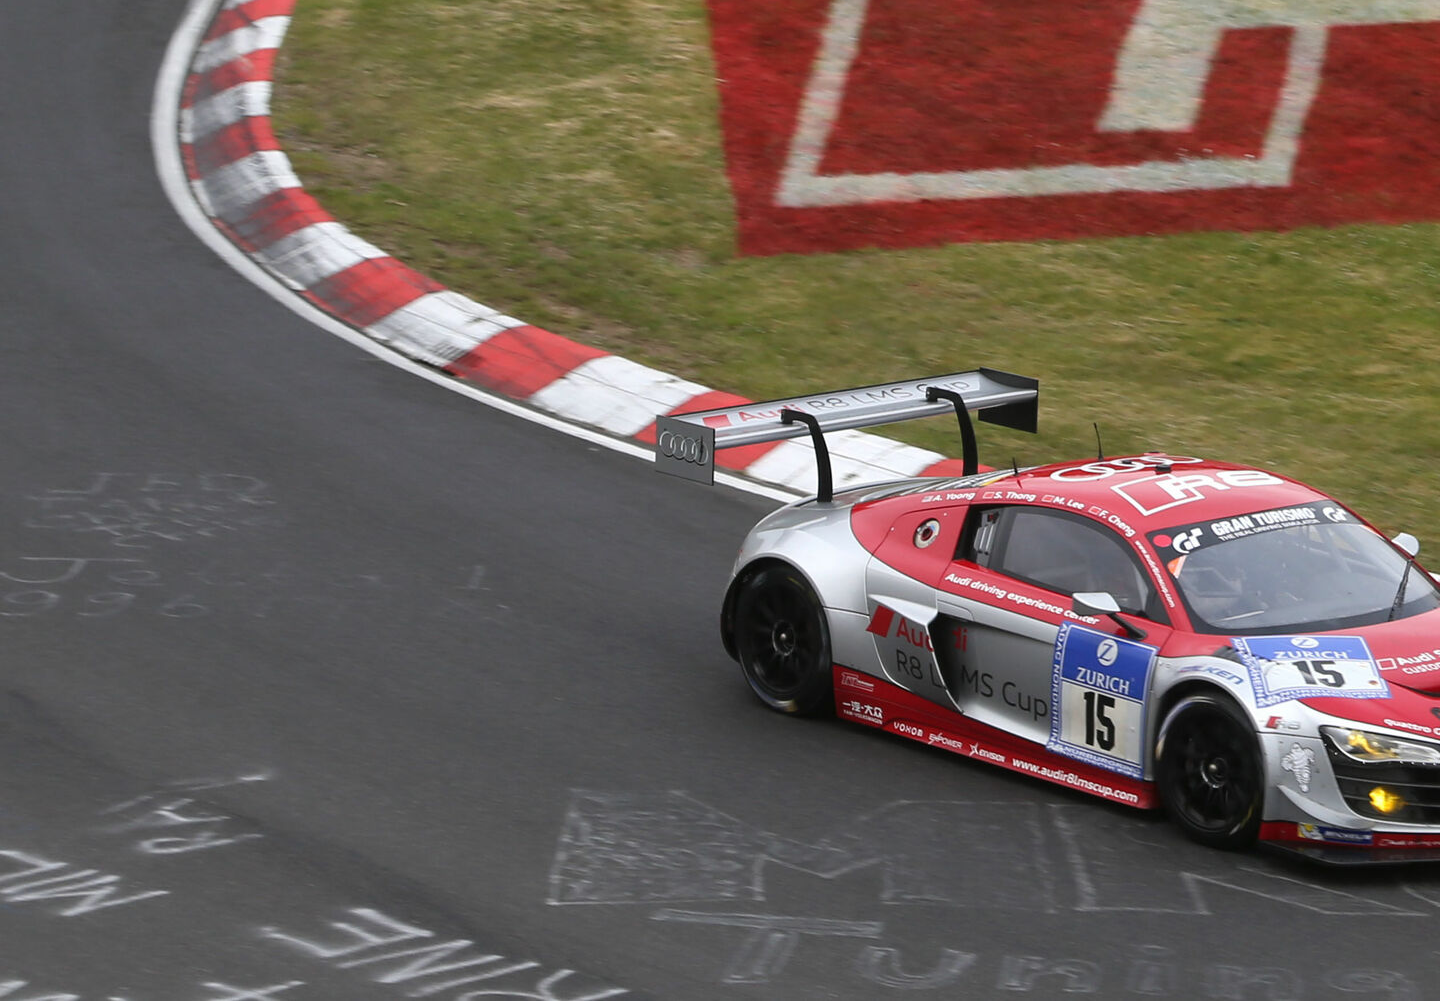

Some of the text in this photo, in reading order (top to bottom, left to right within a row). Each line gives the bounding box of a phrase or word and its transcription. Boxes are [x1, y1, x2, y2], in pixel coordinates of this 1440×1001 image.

[806, 397, 849, 411] R8
[852, 386, 907, 406] LMS
[946, 491, 977, 502] Yoong
[1005, 491, 1037, 503] Thong
[1068, 499, 1086, 511] Lee
[1108, 514, 1137, 538] Cheng
[1210, 506, 1316, 536] GRAN TURISMO
[945, 572, 970, 587] Audi
[970, 580, 1006, 600] driving
[1006, 590, 1063, 616] experience
[1274, 650, 1349, 659] ZURICH
[1396, 651, 1437, 667] Audi
[896, 649, 923, 680] R8
[1002, 681, 1048, 721] Cup
[1076, 666, 1130, 695] ZURICH
[1293, 660, 1347, 688] 15
[1083, 691, 1116, 752] 15
[1383, 718, 1432, 734] quattro
[1012, 756, 1139, 803] www.audir8lmscup.com
